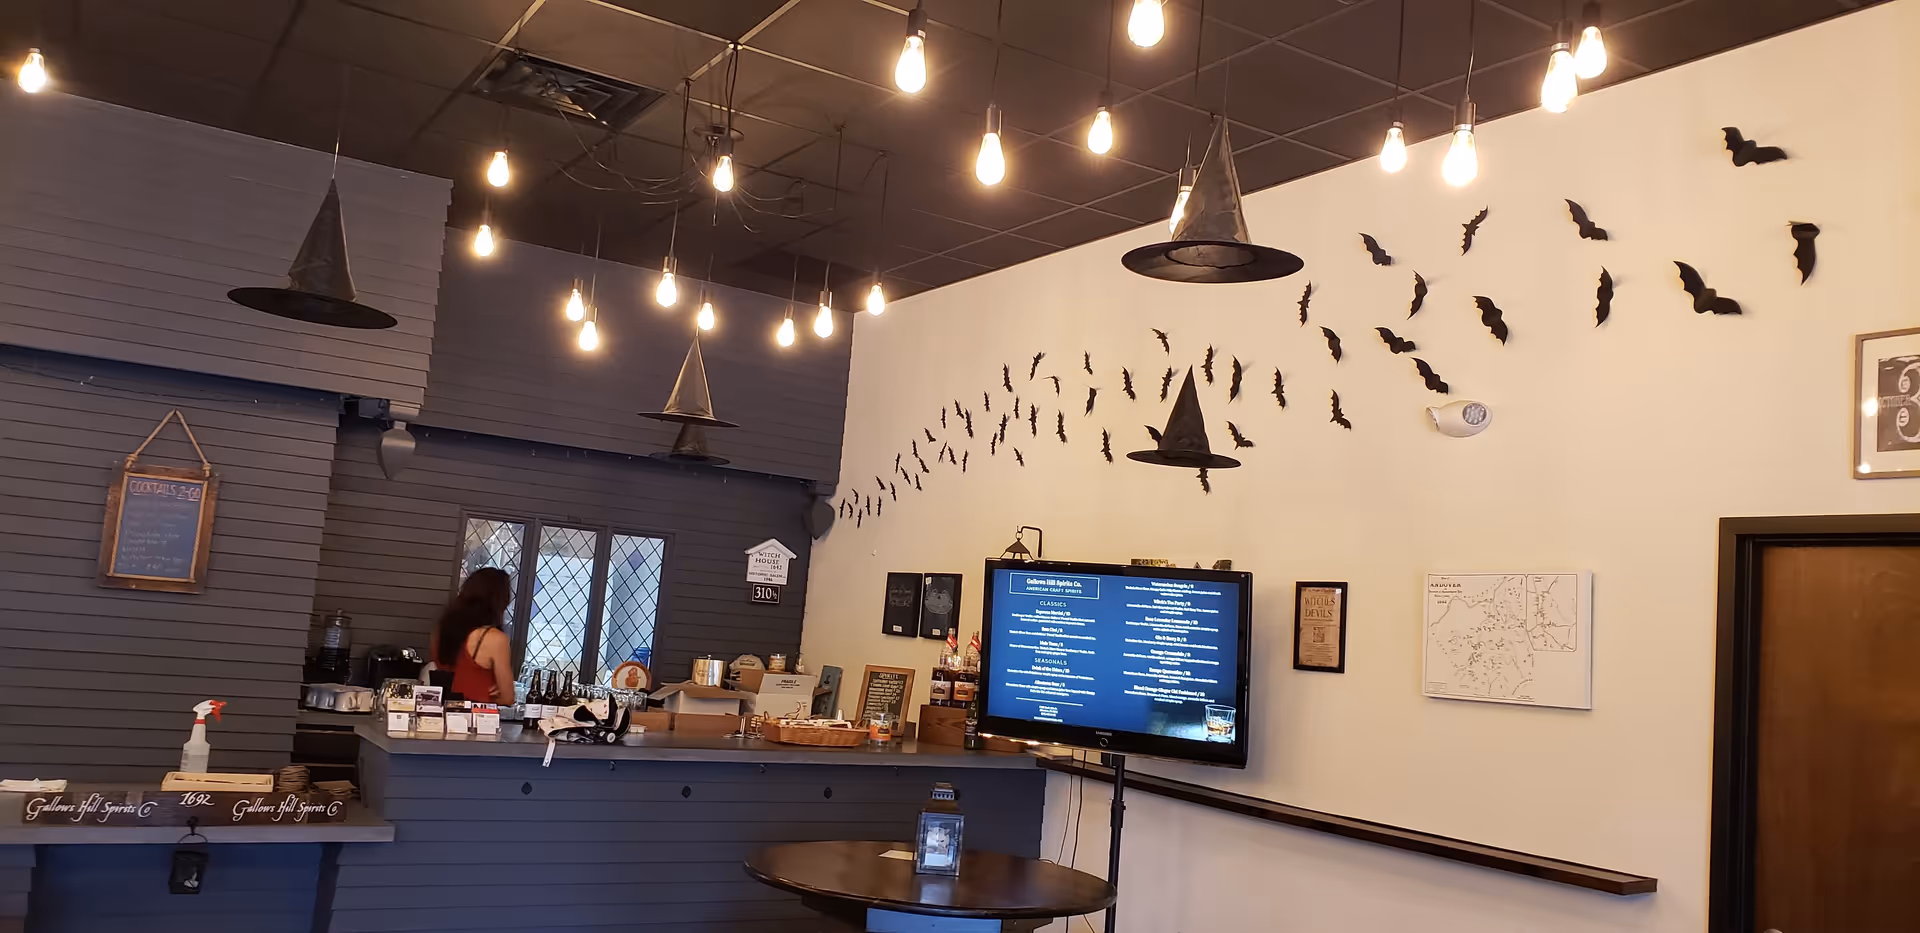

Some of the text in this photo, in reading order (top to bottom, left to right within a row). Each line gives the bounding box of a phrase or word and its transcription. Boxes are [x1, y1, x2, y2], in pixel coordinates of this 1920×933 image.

[1304, 597, 1336, 606] WITCHES
[1304, 608, 1333, 617] DEVILS
[1034, 657, 1068, 666] SEASONALS
[178, 791, 215, 808] 1692
[26, 796, 75, 821] Gallows
[70, 793, 102, 822] Hill
[97, 799, 137, 823] Spirits
[232, 797, 275, 822] Gallows
[271, 793, 300, 822] Hill
[294, 800, 326, 822] Spirits
